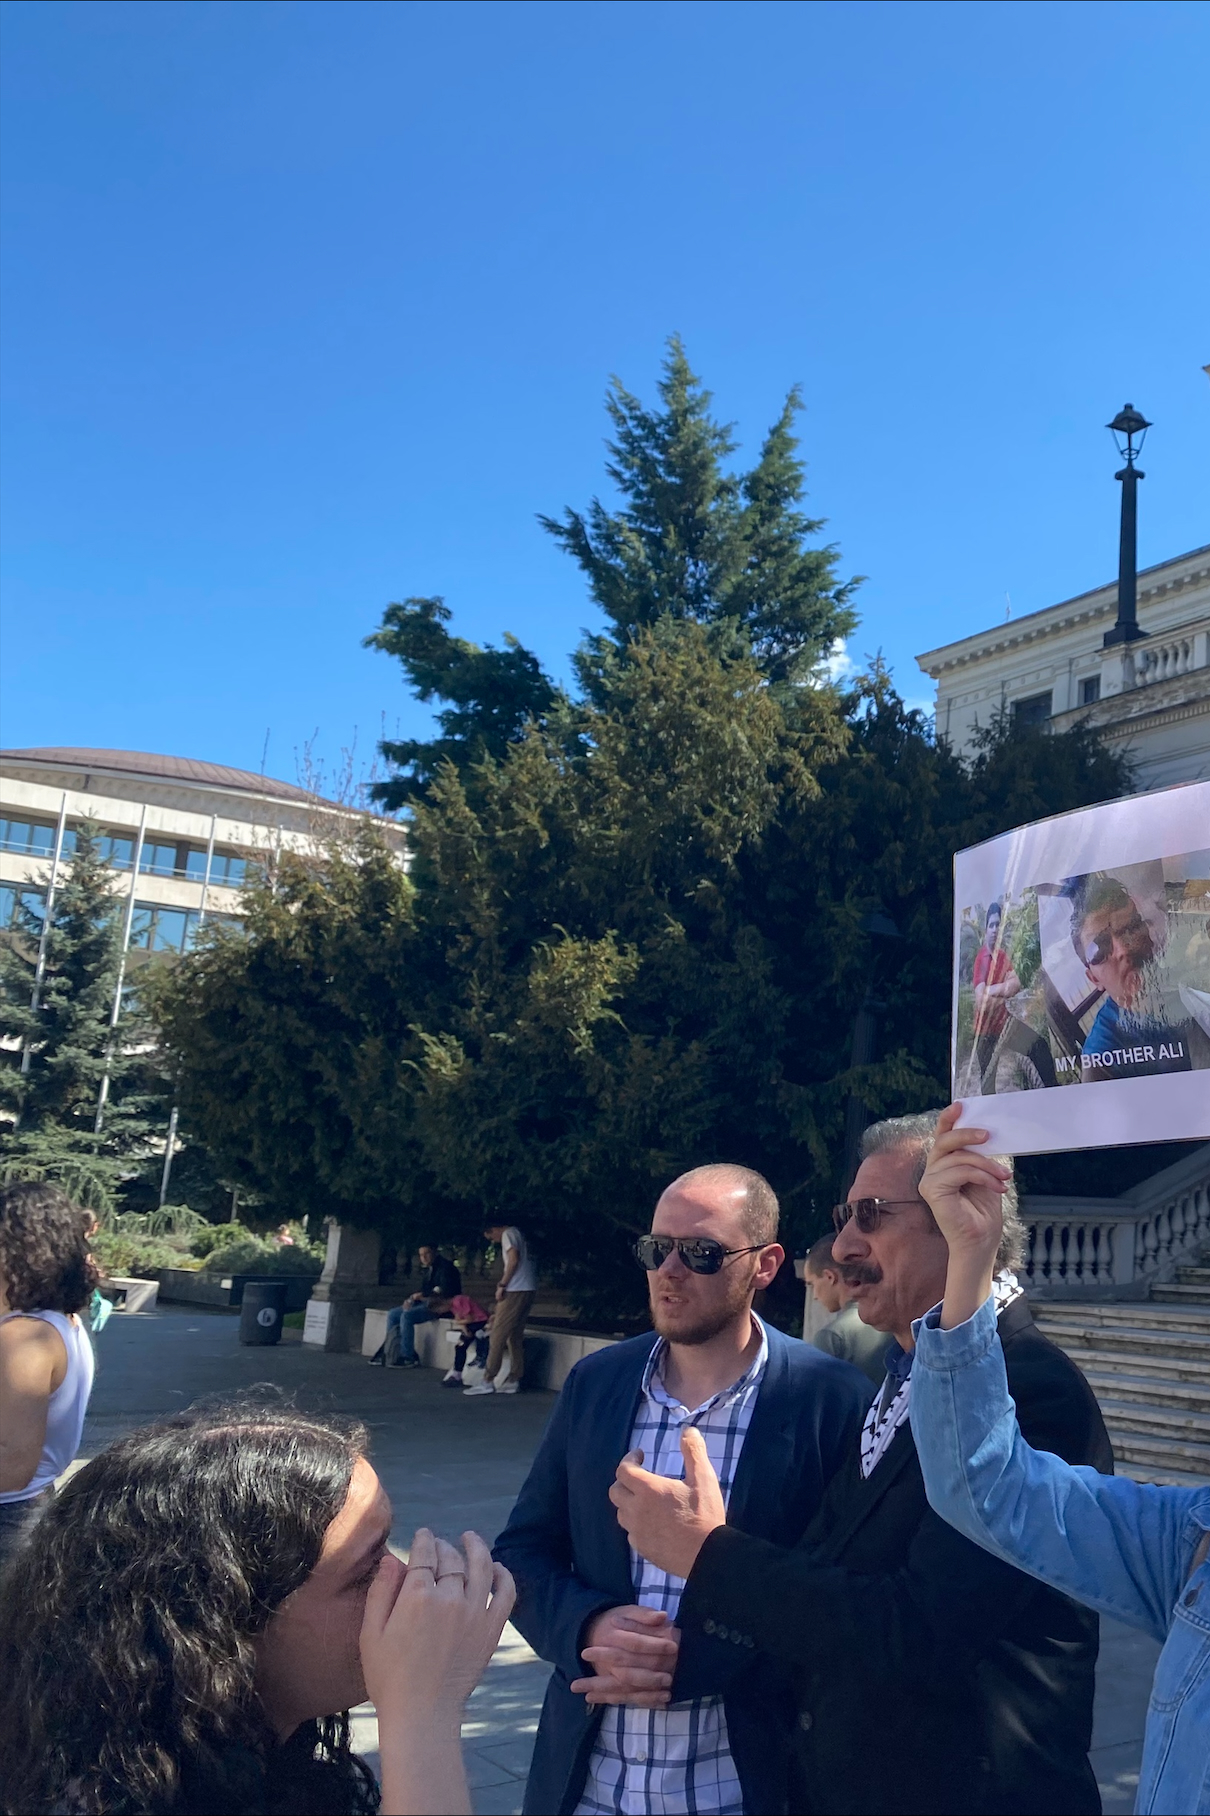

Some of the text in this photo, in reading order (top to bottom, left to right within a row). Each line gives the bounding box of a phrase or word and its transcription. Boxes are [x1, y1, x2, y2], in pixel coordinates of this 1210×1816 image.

[1055, 1042, 1184, 1073] MY BROTHER ALI
